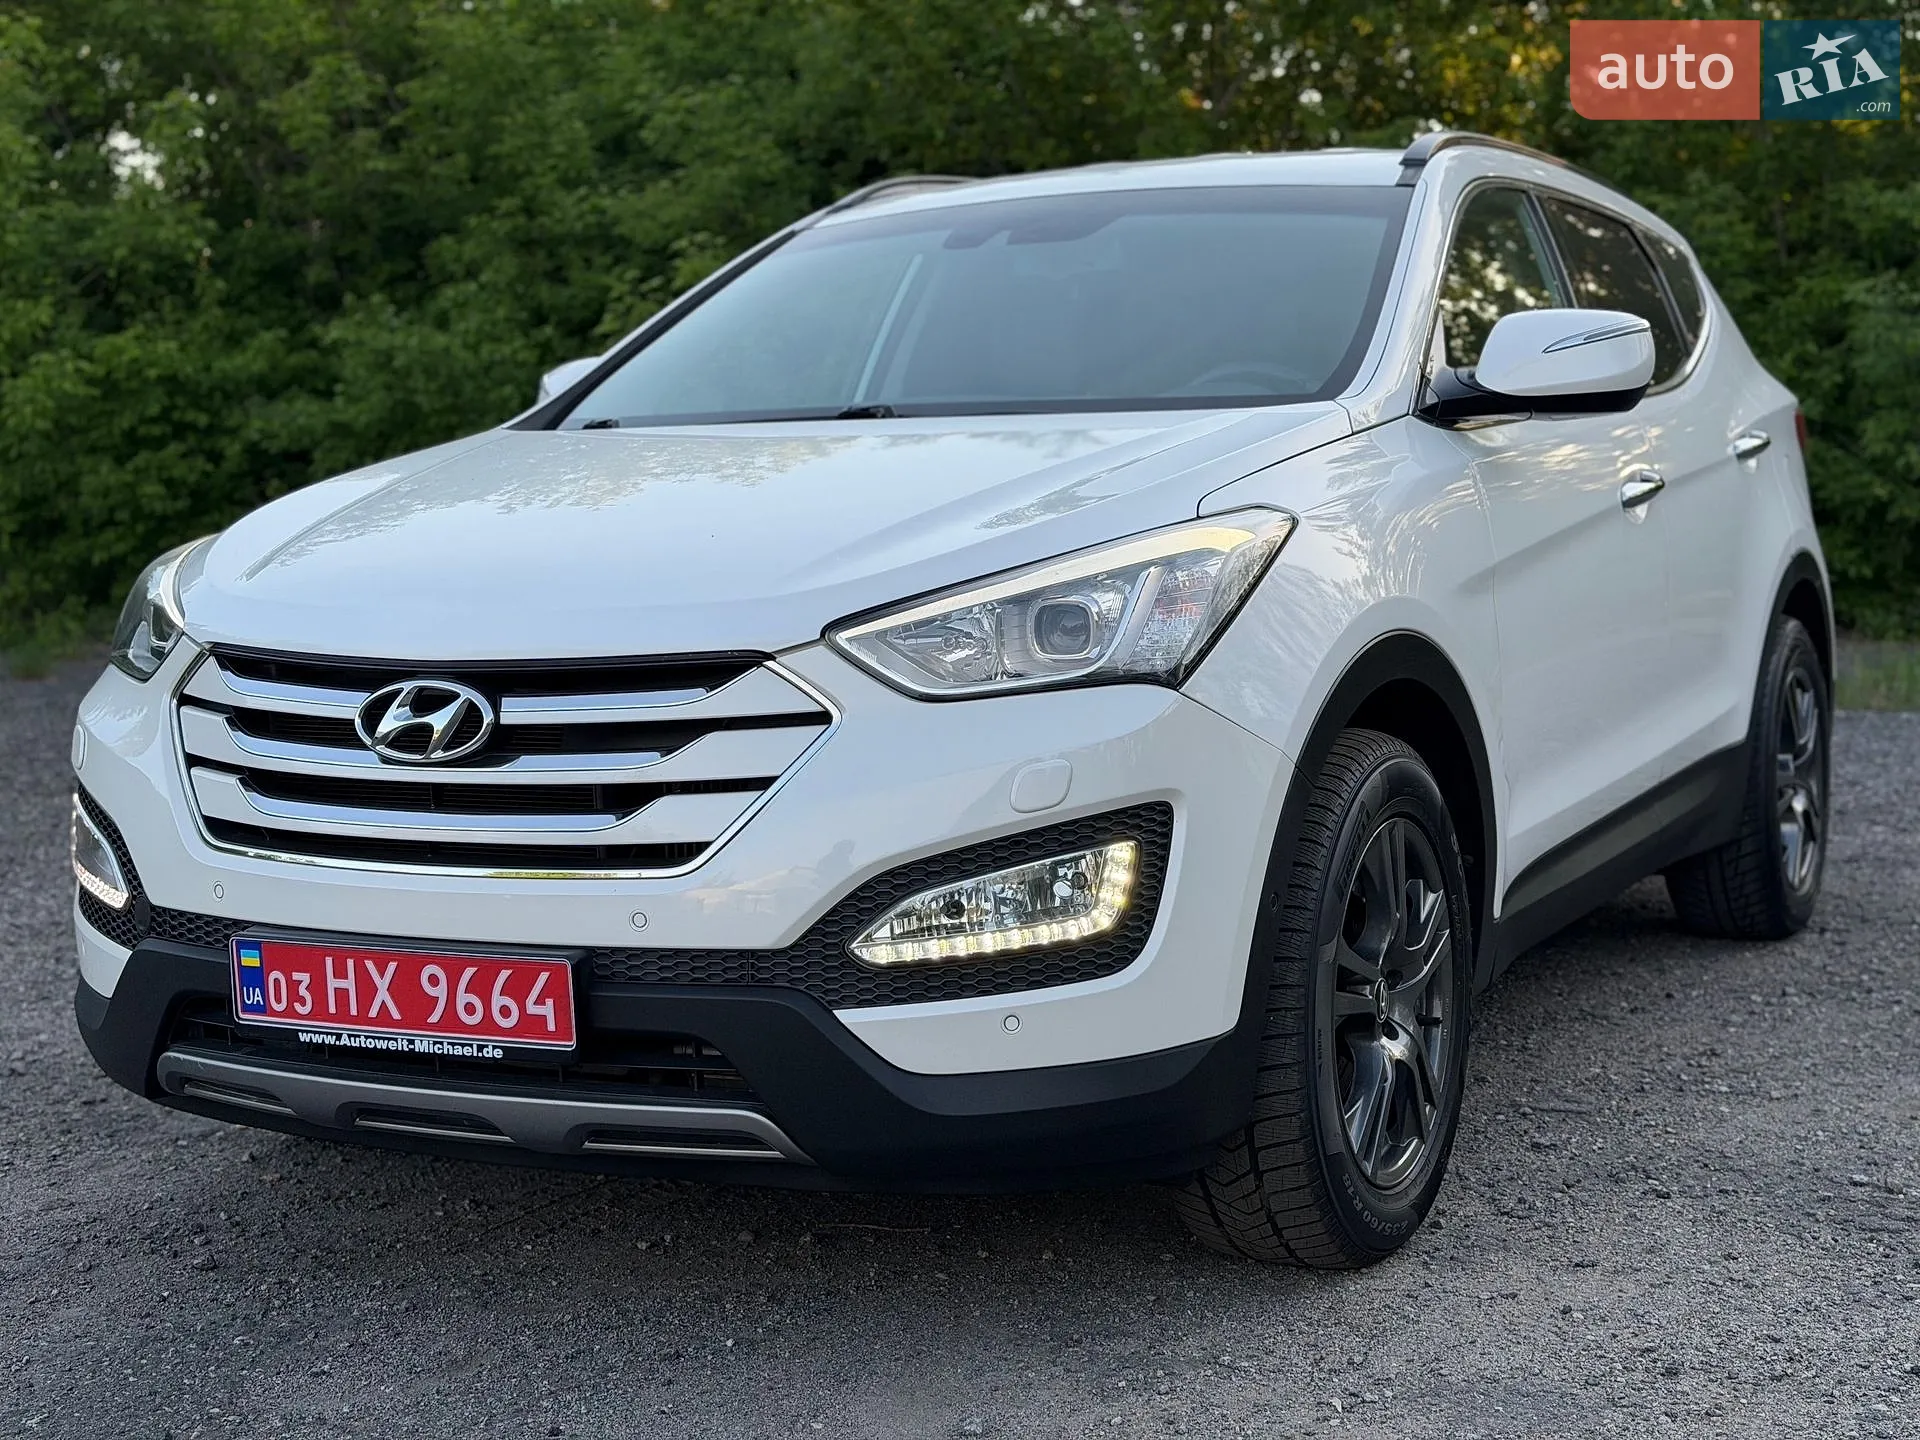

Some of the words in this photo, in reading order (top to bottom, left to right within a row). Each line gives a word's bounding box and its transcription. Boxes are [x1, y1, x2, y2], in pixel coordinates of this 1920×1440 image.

[243, 986, 264, 1006] UA
[267, 970, 313, 1016] 03
[325, 956, 402, 1020] HX
[420, 964, 556, 1032] 9664
[298, 1031, 504, 1059] www.Autowelt-Michael.de
